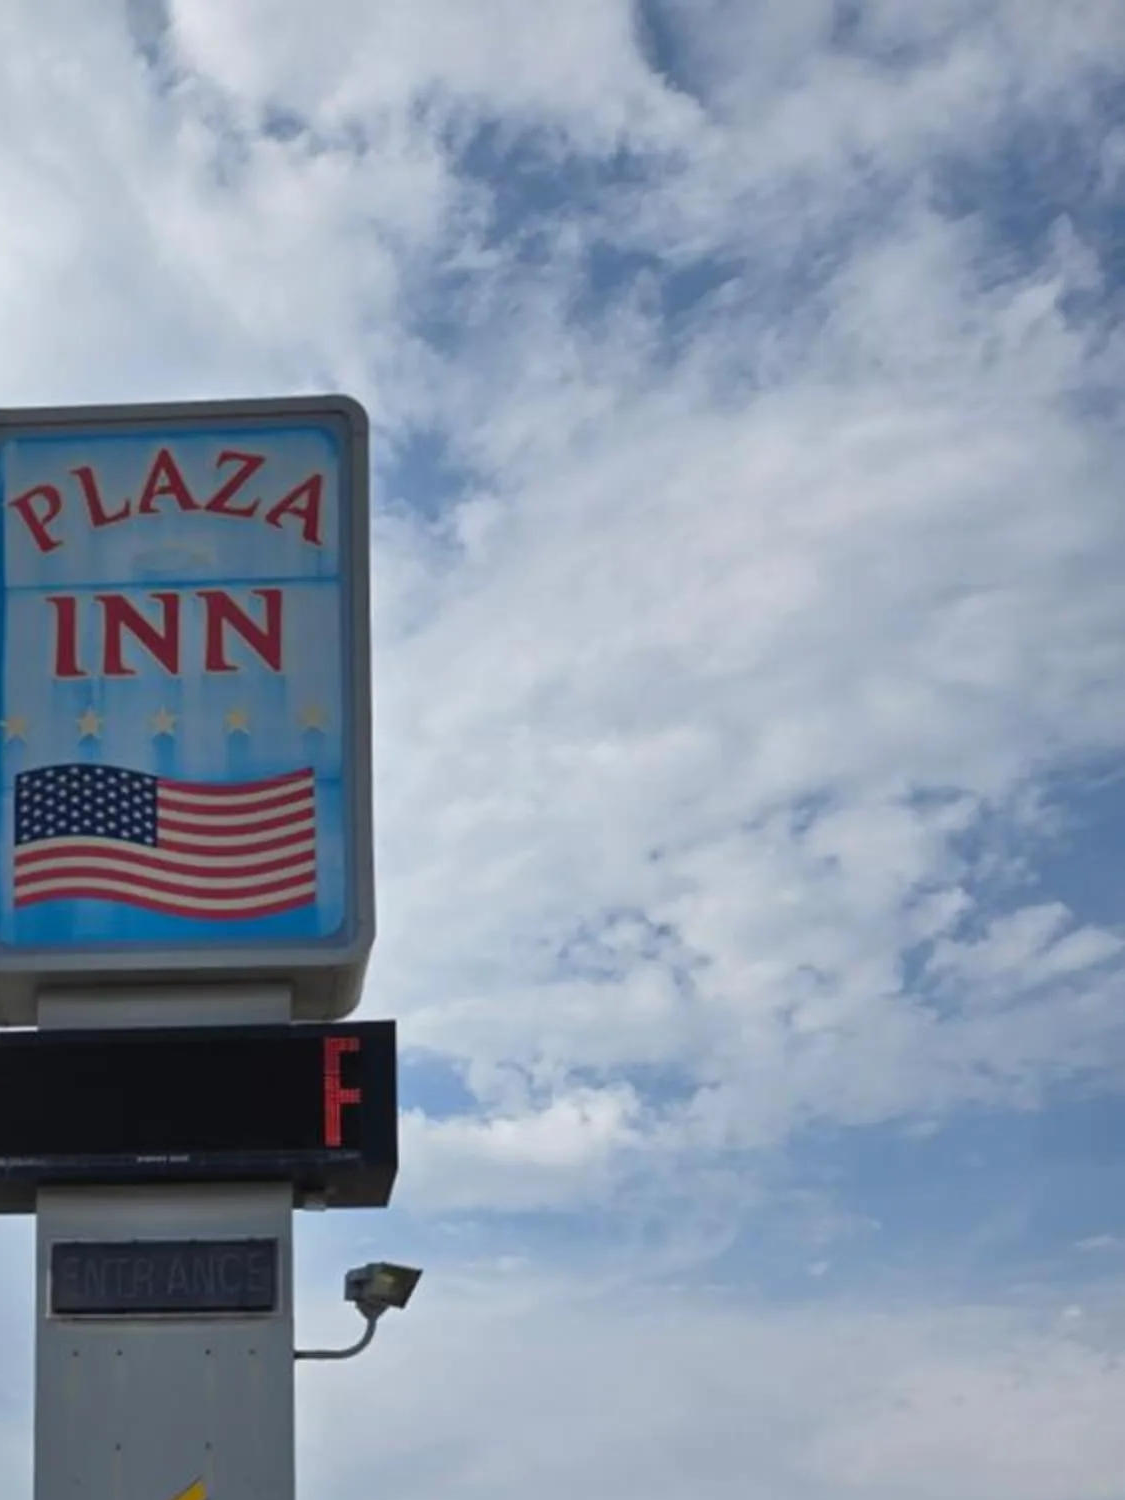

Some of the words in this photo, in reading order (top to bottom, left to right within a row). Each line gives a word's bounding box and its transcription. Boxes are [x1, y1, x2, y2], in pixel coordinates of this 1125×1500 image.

[9, 448, 323, 552] PLAZA
[46, 589, 283, 678] INN
[323, 1037, 361, 1147] F
[62, 1251, 266, 1299] ENTRANCE
